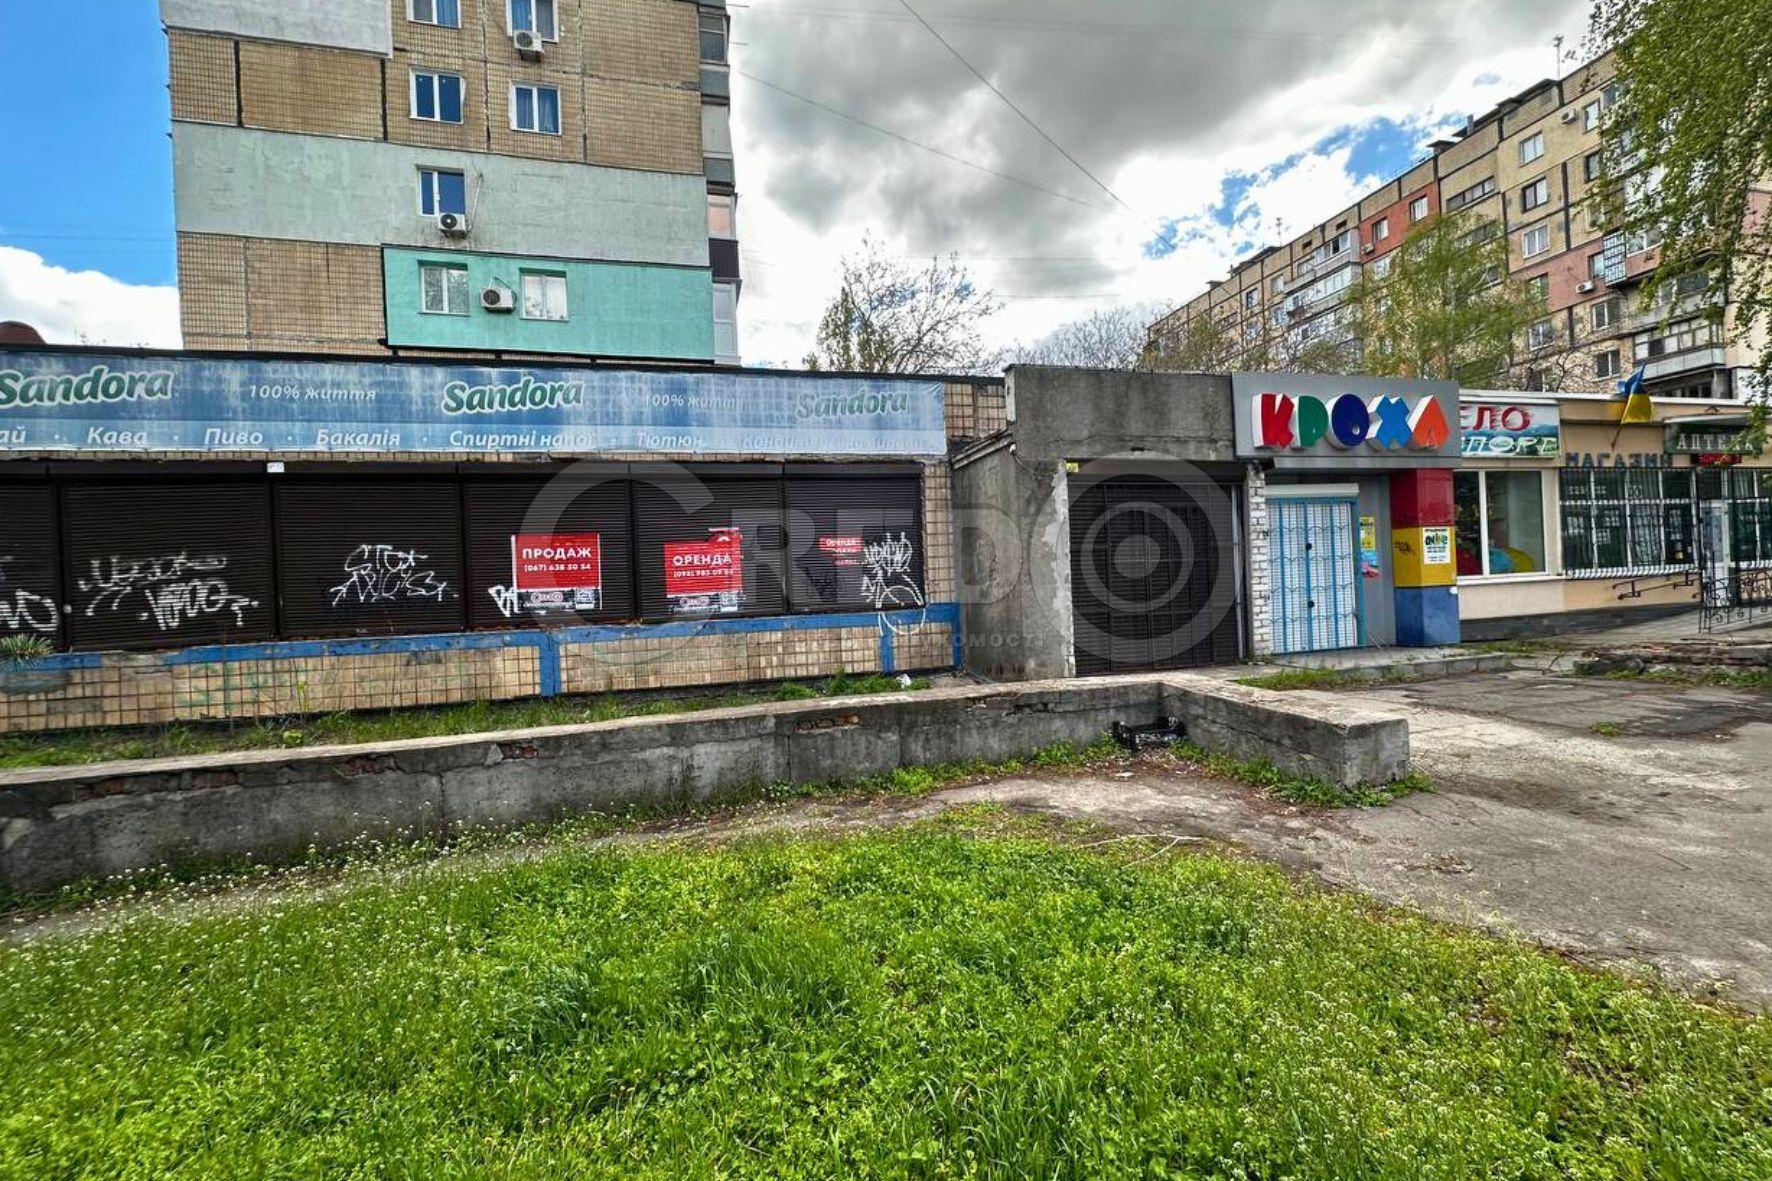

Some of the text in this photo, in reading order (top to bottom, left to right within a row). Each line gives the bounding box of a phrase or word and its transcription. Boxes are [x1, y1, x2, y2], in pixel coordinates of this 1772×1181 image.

[0, 365, 174, 409] Sandora
[250, 385, 377, 401] 100% життя
[442, 376, 585, 415] Sandora
[796, 388, 910, 419] Sandora
[1252, 393, 1450, 450] КРОХА
[87, 427, 148, 445] Кава
[204, 428, 264, 446] Пиво
[316, 429, 401, 447] Бакалія
[450, 430, 537, 450] Спиртні
[522, 547, 592, 561] ПРОДАЖ
[673, 553, 732, 567] ОРЕНДА
[524, 563, 547, 573] (067)
